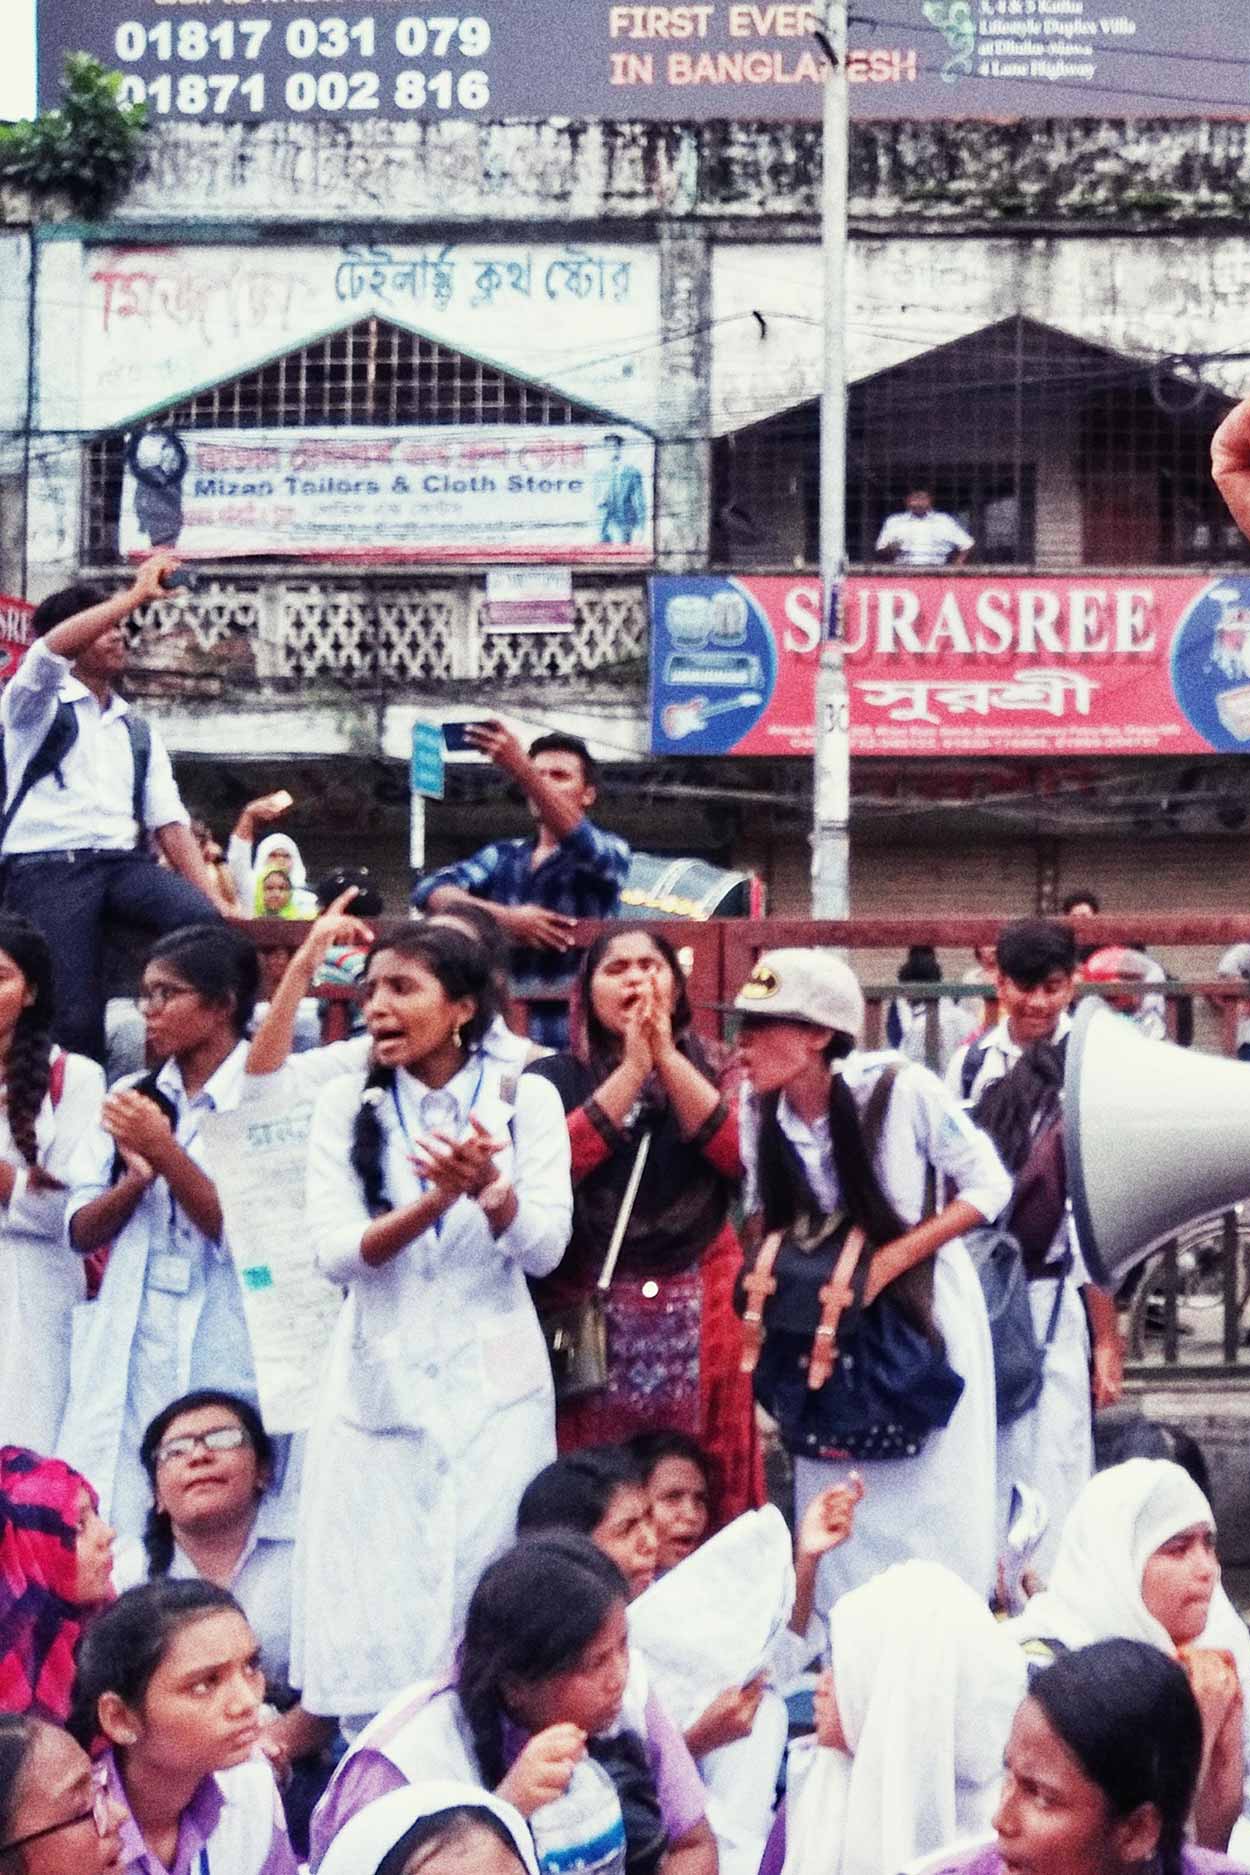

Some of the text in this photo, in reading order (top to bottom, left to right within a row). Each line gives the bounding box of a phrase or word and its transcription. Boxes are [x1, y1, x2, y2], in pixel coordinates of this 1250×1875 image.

[114, 16, 491, 62] 01817 031 079
[608, 6, 714, 38] FIRST
[609, 49, 917, 84] IN BANGLAESH
[115, 70, 491, 114] 01871 002 816
[194, 473, 585, 499] Mizan Tailors & Cloth Store
[783, 586, 1157, 655] SURASREE
